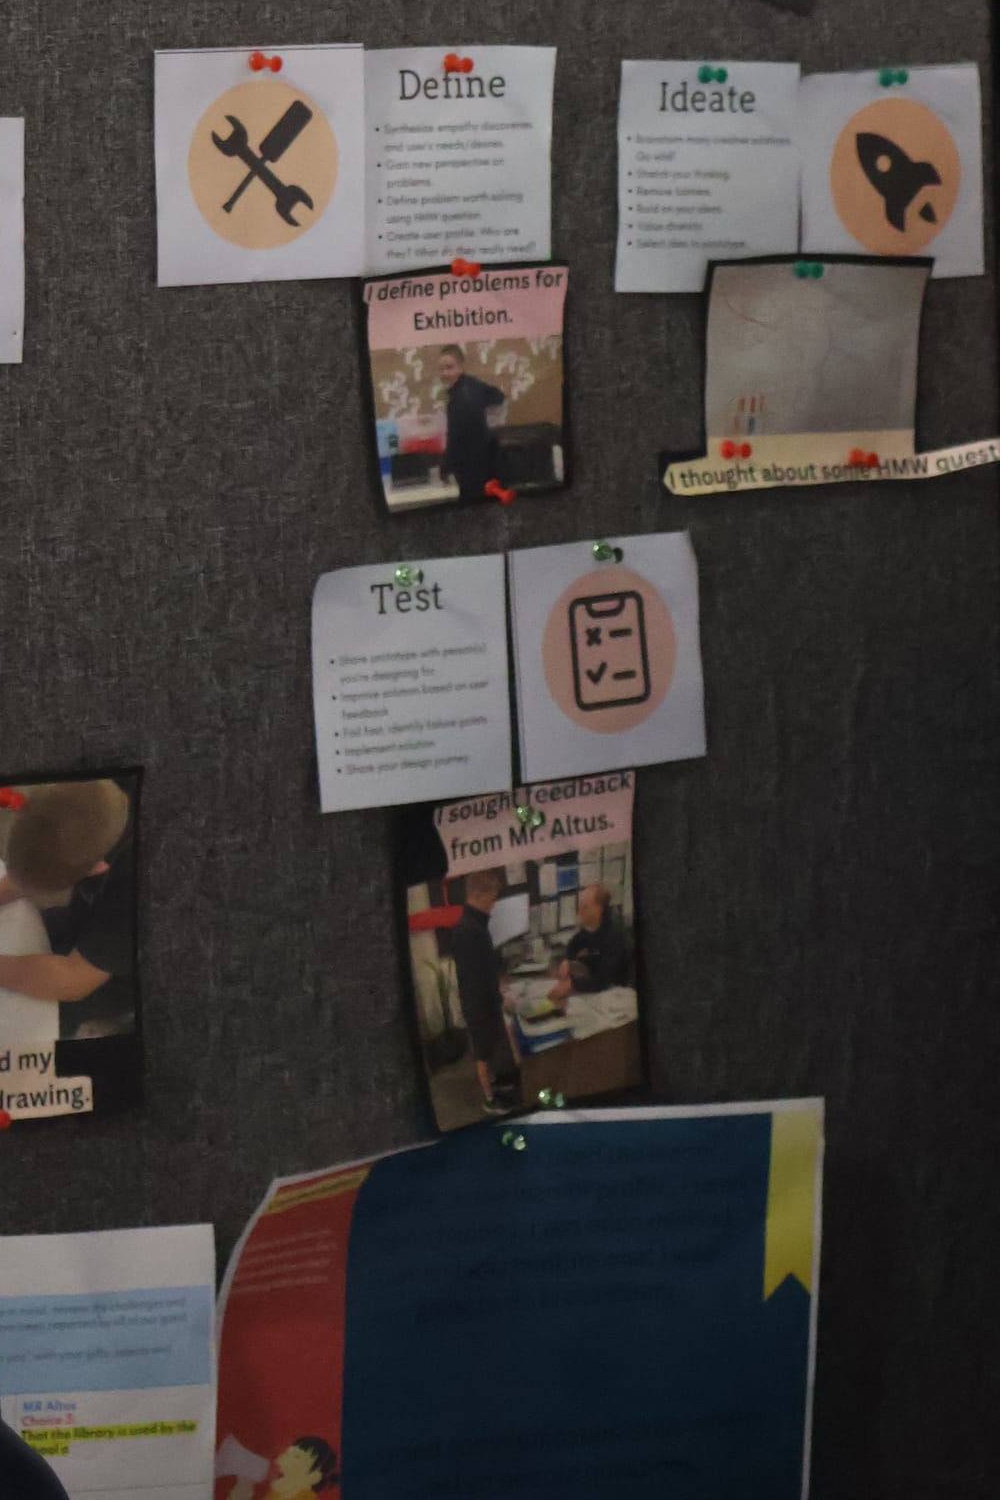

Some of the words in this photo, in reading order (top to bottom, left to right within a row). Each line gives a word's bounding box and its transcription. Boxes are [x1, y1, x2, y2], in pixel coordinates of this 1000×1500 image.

[398, 69, 506, 101] Define
[659, 81, 756, 114] Ideate
[377, 280, 435, 301] define
[440, 273, 530, 301] problems
[535, 269, 564, 289] for
[414, 307, 513, 332] Exhibition.
[680, 464, 756, 490] thought
[761, 463, 817, 483] about
[821, 461, 872, 481] some
[877, 456, 929, 478] HMW
[370, 581, 444, 615] Test
[525, 772, 632, 805] feedback
[451, 831, 503, 861] from
[18, 1051, 52, 1075] my
